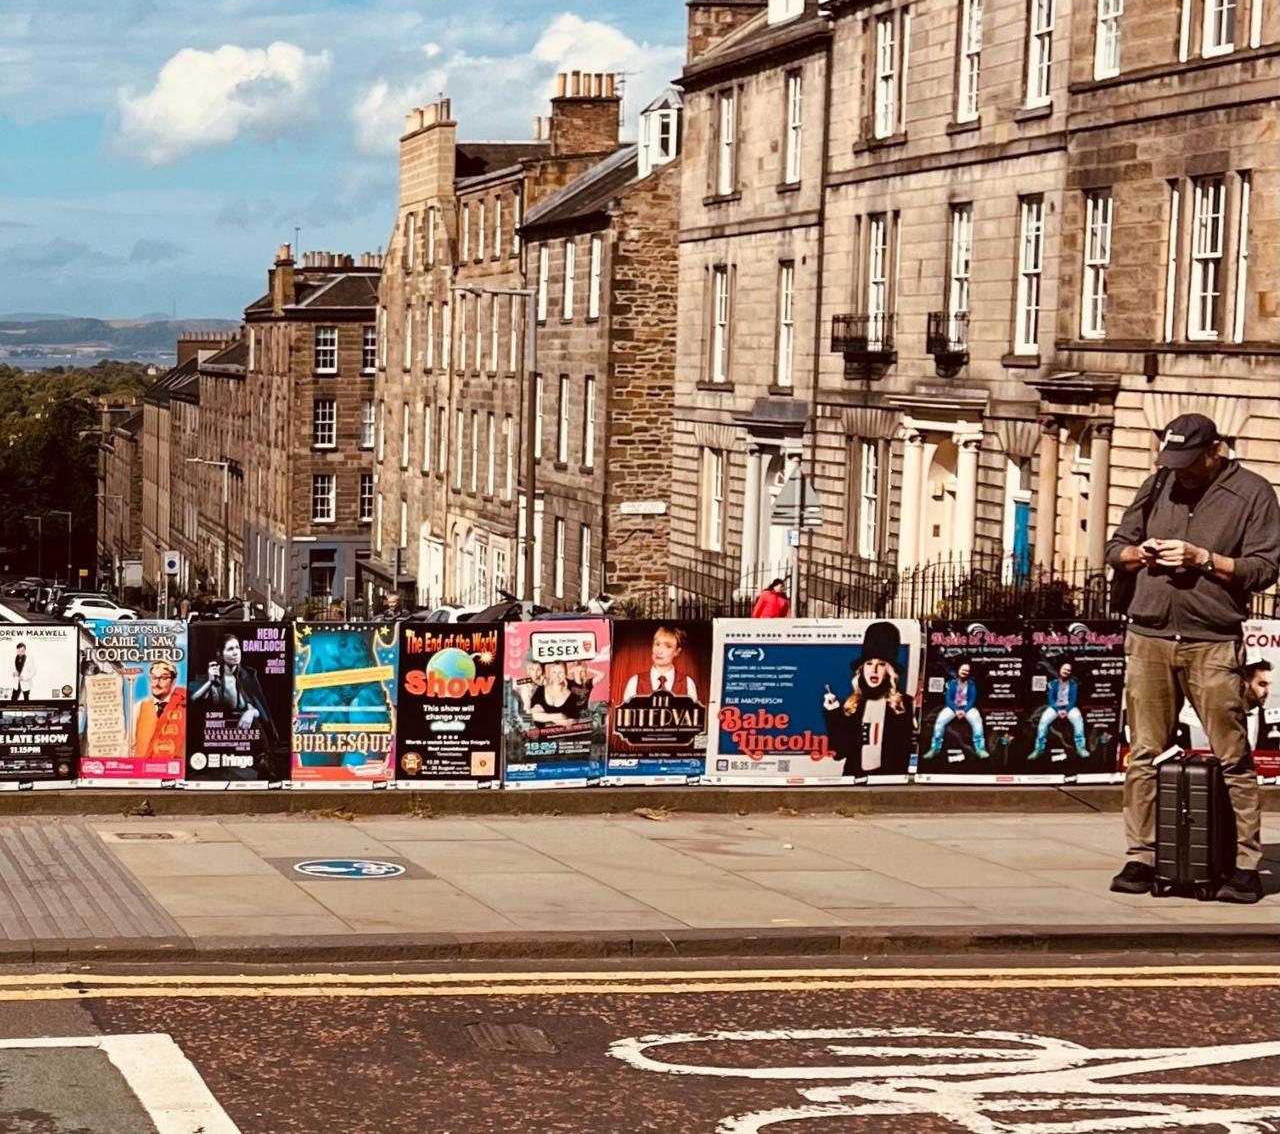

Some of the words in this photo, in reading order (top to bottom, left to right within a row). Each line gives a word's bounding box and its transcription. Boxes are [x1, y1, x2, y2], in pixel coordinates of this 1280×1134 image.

[101, 626, 122, 634] TOM
[127, 626, 169, 634] CROSBIE
[257, 628, 279, 639] HERO
[406, 629, 422, 653] The
[425, 632, 442, 652] End
[444, 634, 454, 649] of
[456, 634, 470, 651] the
[472, 630, 497, 653] World
[931, 632, 968, 646] Made
[969, 633, 982, 645] of
[984, 632, 1023, 646] Magic
[1032, 632, 1068, 645] Made
[1070, 633, 1083, 645] of
[1085, 631, 1123, 645] Magic
[96, 648, 183, 662] CONQ-NERD
[538, 646, 579, 657] ESSEX
[404, 670, 496, 698] Show
[617, 708, 703, 727] INTERVAL
[718, 706, 789, 732] Babe
[6, 734, 33, 744] LATE
[34, 733, 68, 744] SHOW
[292, 733, 392, 755] BURLESQUE
[732, 729, 836, 761] Lincoln
[222, 754, 254, 768] fringe
